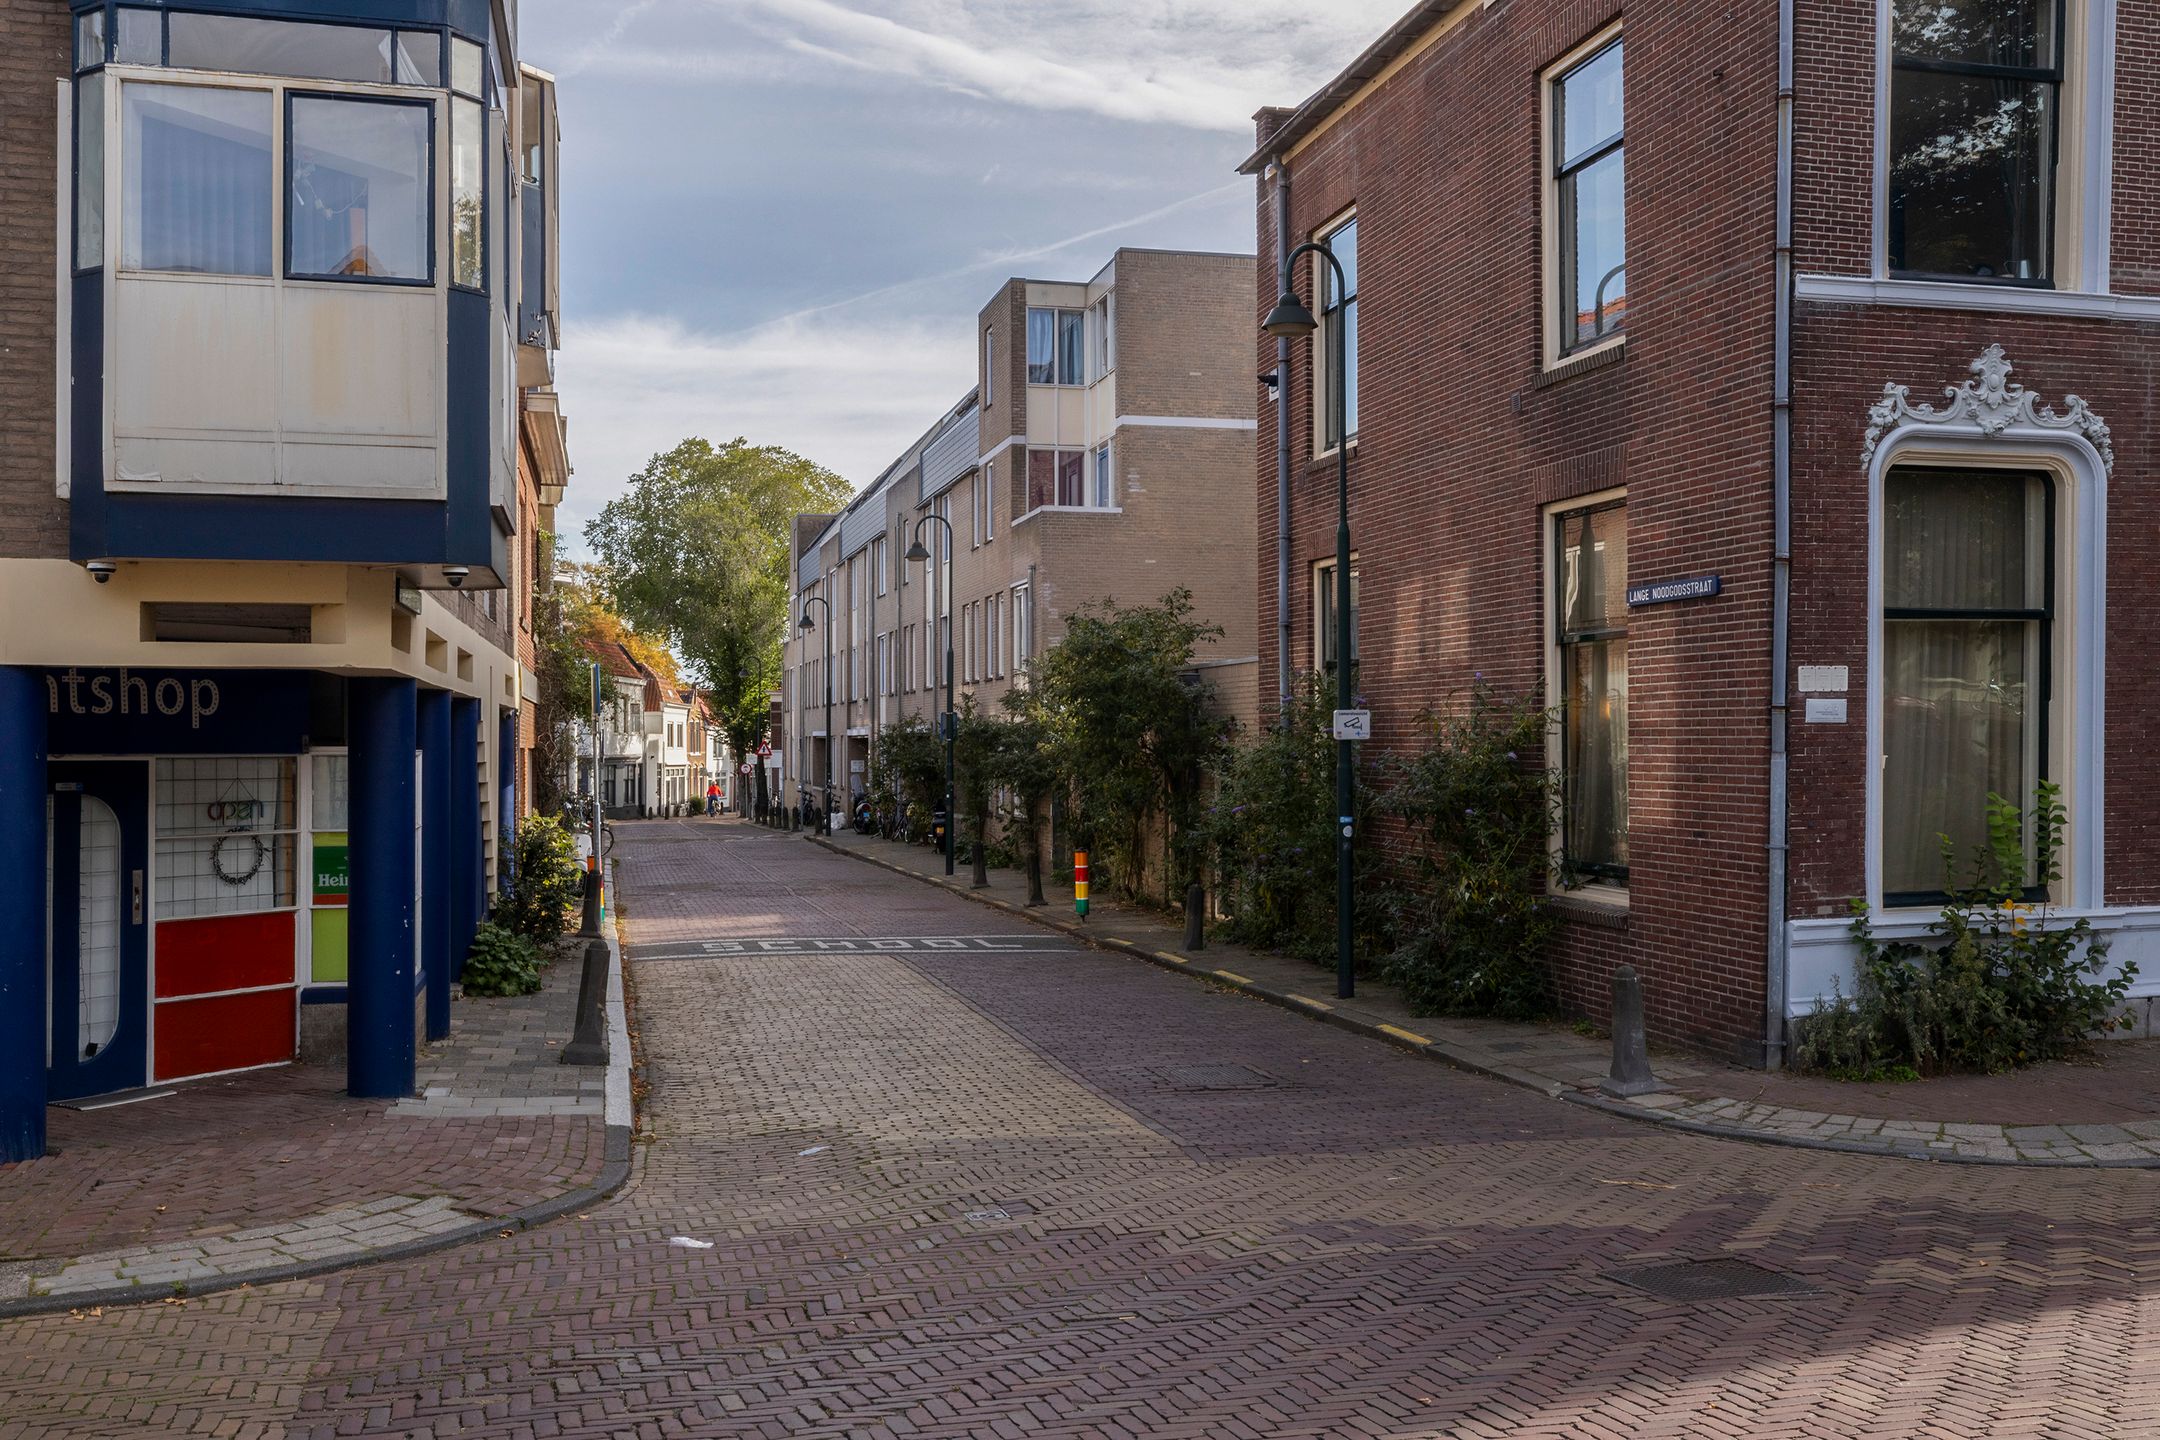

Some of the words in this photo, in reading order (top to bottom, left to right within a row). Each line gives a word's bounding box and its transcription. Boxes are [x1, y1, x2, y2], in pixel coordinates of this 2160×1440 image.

[1629, 589, 1649, 602] LANGE
[1652, 579, 1713, 600] NOODGODSSTRAAT
[207, 800, 264, 826] open
[318, 873, 348, 887] Hei
[701, 938, 1024, 952] SCHOOL
